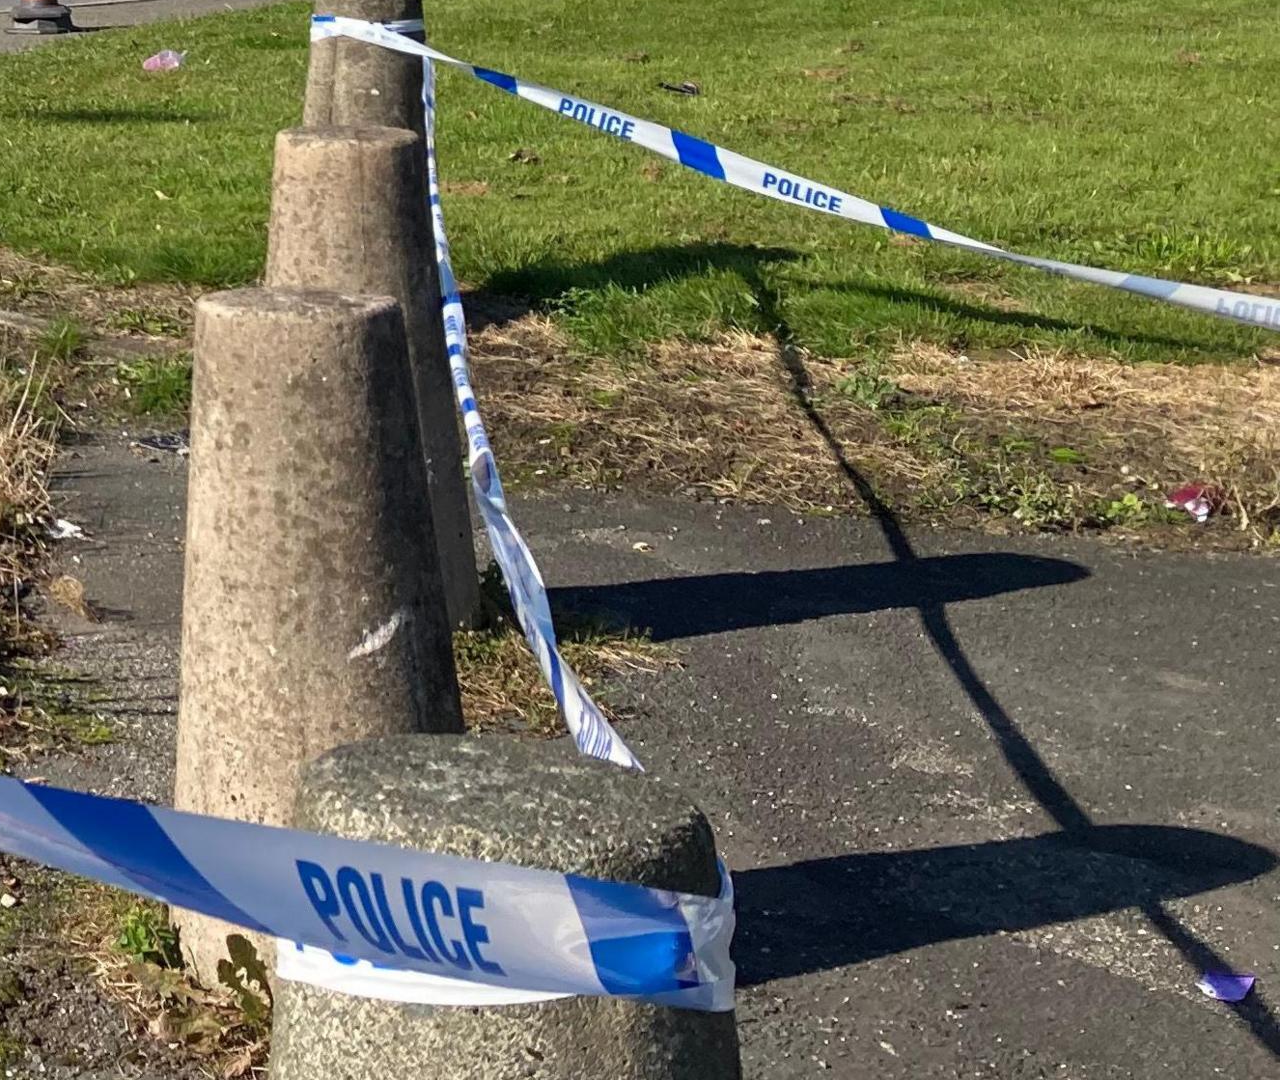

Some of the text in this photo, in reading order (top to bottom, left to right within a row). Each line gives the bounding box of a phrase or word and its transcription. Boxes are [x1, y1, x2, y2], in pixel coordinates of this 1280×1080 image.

[557, 97, 636, 142] POLICE
[762, 172, 842, 215] POLICE
[295, 859, 508, 977] POLICE
